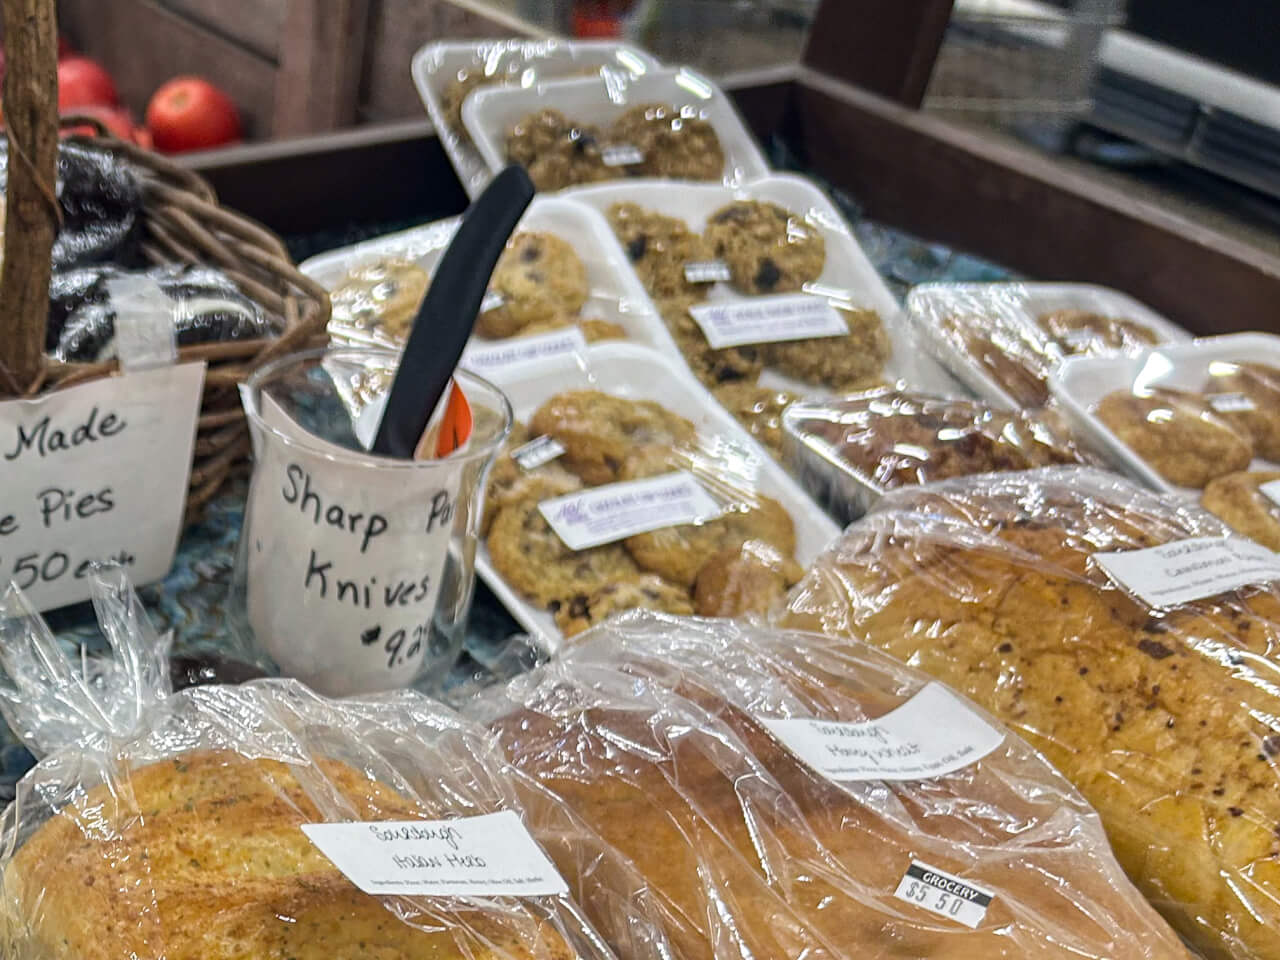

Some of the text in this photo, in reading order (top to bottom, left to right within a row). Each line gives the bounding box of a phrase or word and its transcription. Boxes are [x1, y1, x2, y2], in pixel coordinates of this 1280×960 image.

[5, 406, 128, 461] Made
[36, 485, 116, 528] Pies
[282, 463, 389, 554] Sharp
[304, 549, 430, 608] Knives
[905, 881, 931, 903] $5
[922, 872, 978, 901] GROCERY
